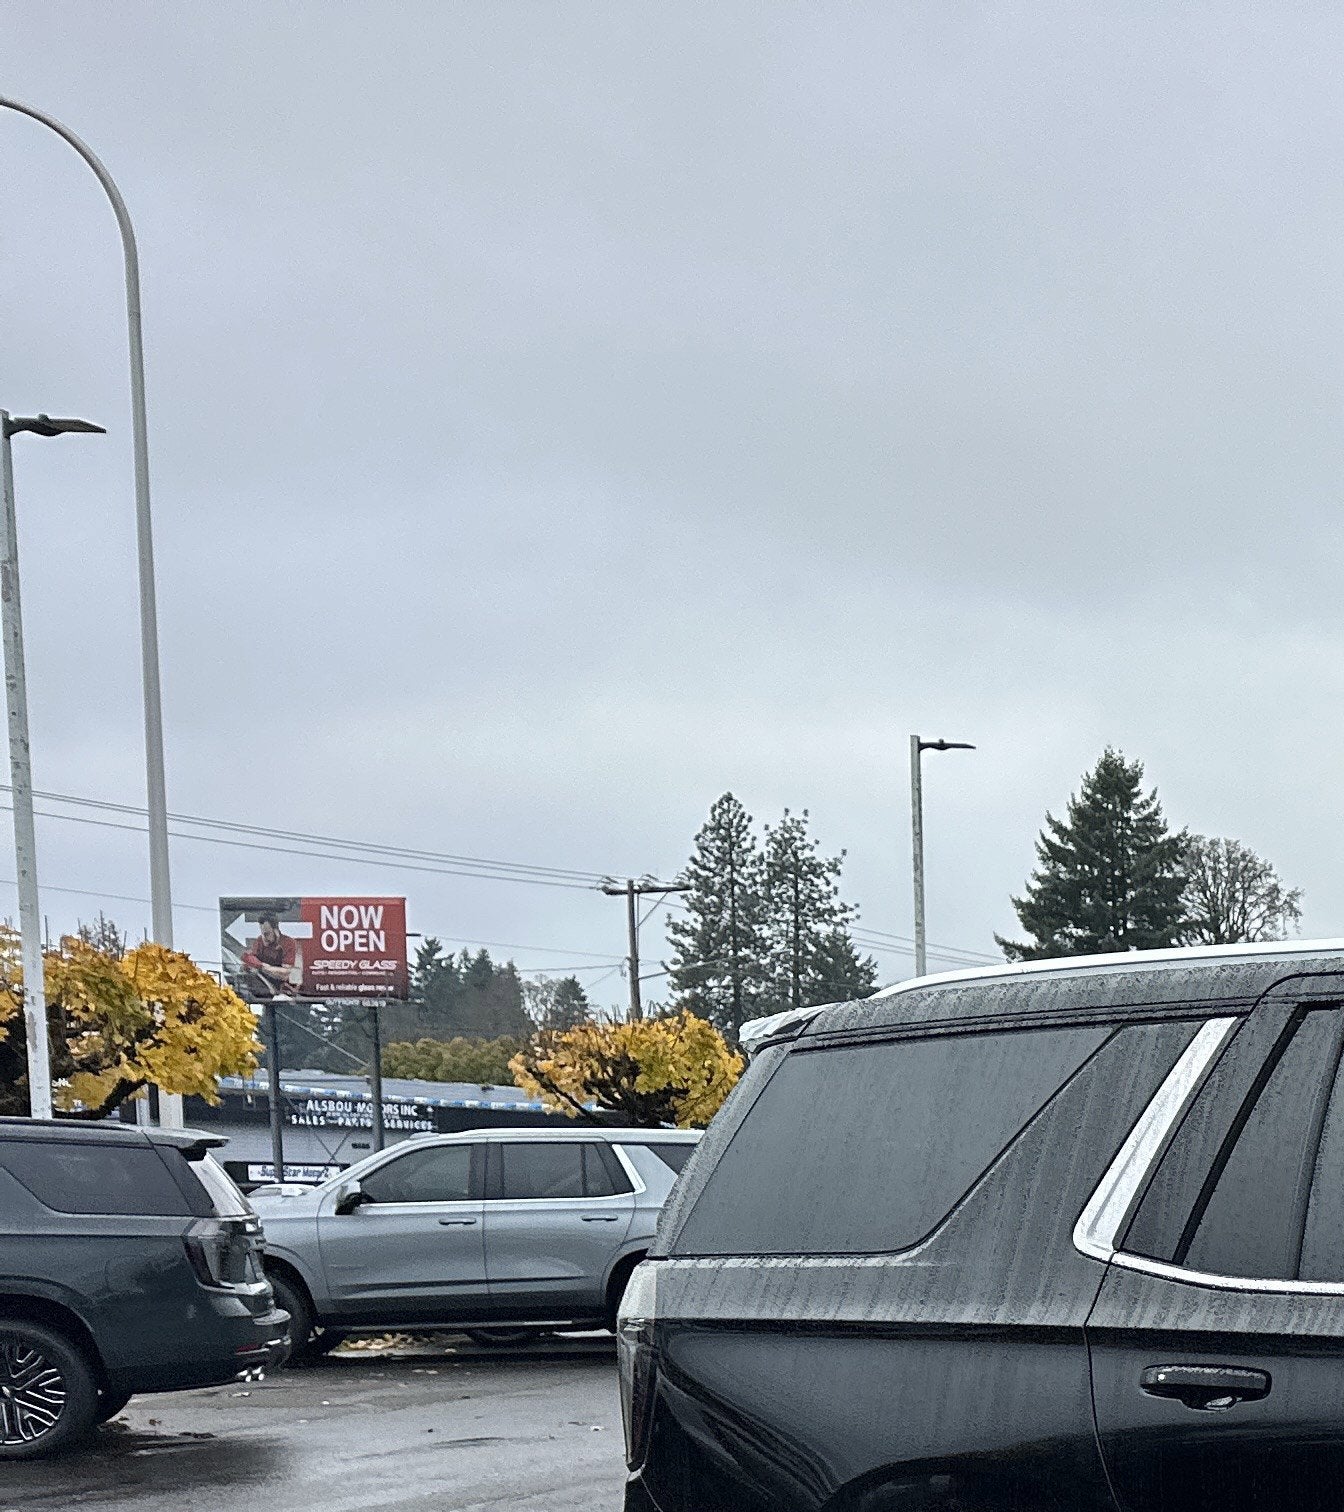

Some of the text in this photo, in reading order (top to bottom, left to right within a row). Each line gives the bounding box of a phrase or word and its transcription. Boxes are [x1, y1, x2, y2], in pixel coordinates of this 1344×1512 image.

[320, 905, 384, 930] NOW
[320, 929, 387, 953] OPEN
[309, 959, 398, 970] SPEEDY GLASS
[315, 983, 329, 992] Fast
[306, 1099, 352, 1112] ALSBOU
[355, 1101, 399, 1115] MOORS
[400, 1104, 418, 1117] INC
[291, 1114, 326, 1126] SALES
[337, 1116, 373, 1128] PARTS
[383, 1118, 433, 1131] SERVICES
